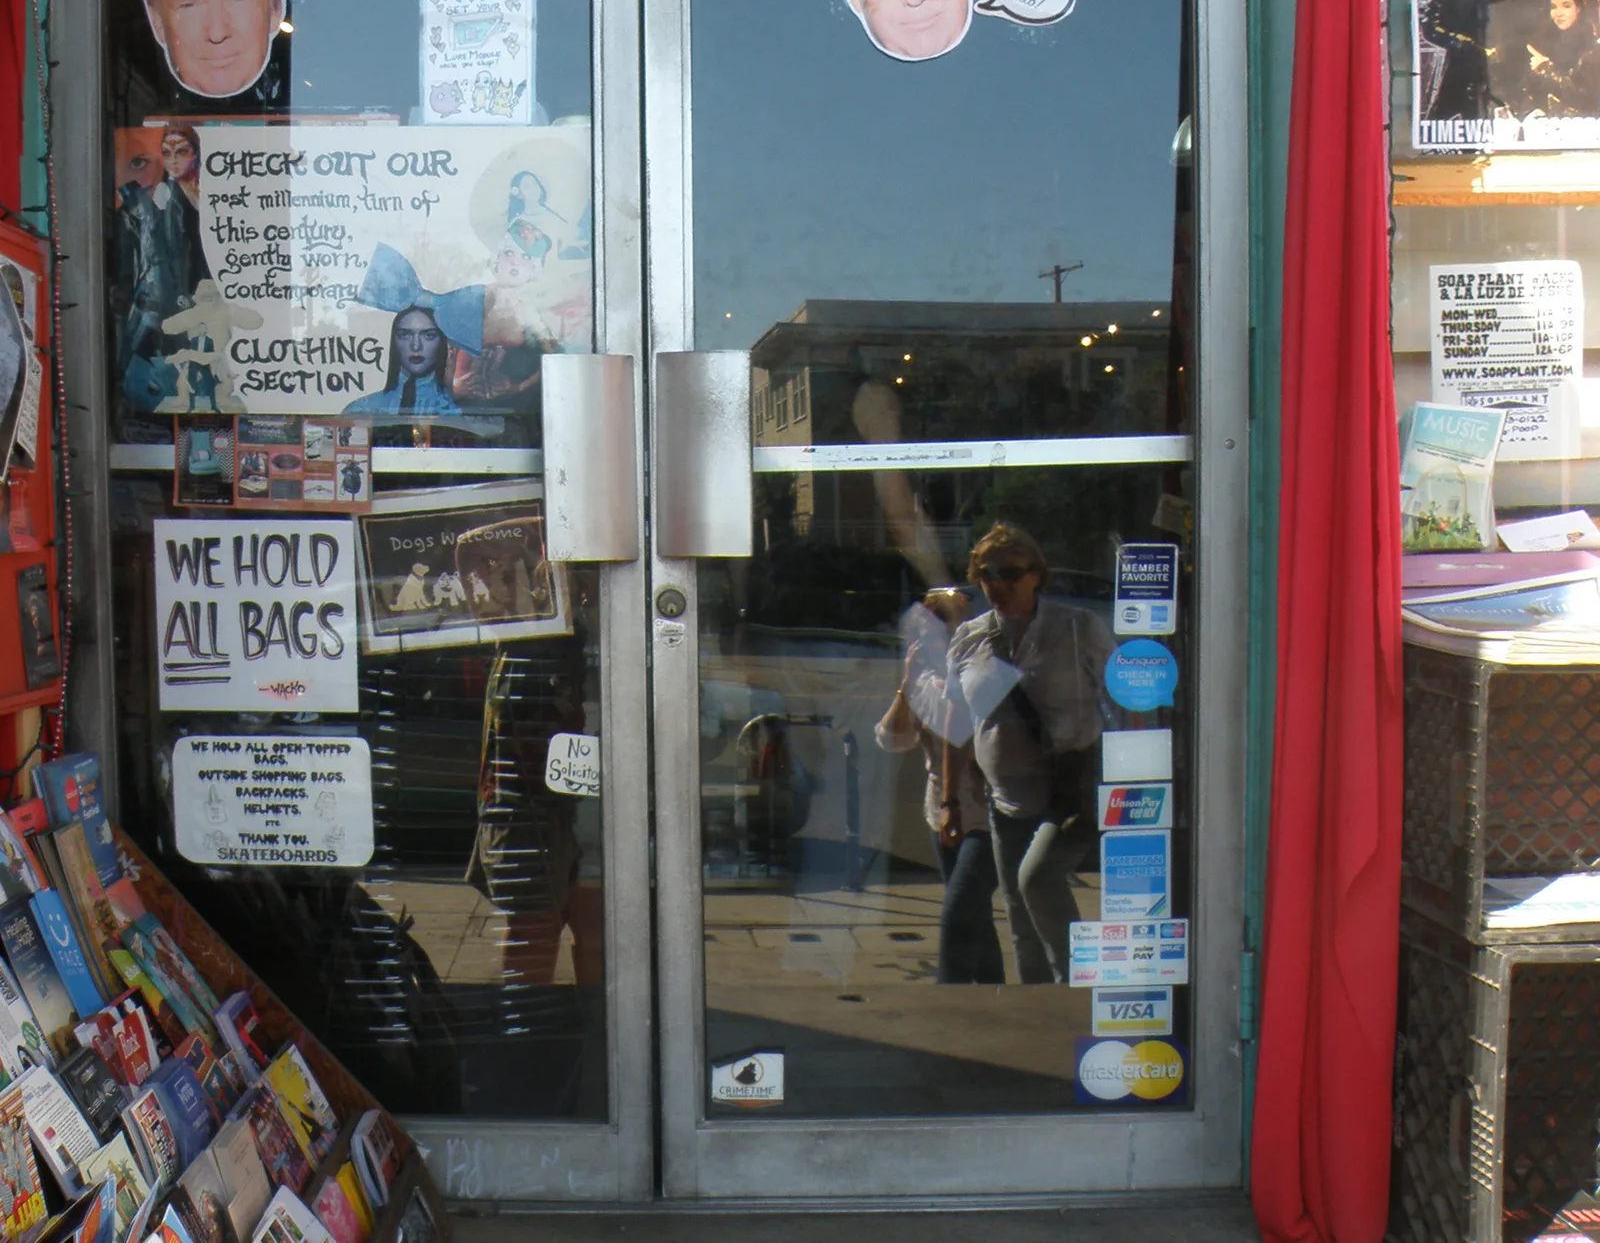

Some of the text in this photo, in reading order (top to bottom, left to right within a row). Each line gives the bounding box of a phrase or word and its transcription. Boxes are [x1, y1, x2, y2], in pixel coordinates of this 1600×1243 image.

[205, 149, 458, 182] CHECK OUT OUR
[208, 185, 440, 217] post millennium, turn of
[210, 215, 354, 250] this century,
[217, 248, 369, 280] gently worn,
[1438, 273, 1475, 288] SOAP
[1478, 273, 1524, 286] PLANT
[1439, 288, 1450, 300] &
[1454, 287, 1474, 300] LA
[1477, 287, 1506, 299] LUZ
[1508, 286, 1525, 298] DE
[230, 335, 385, 371] CLOTHING
[1442, 364, 1574, 380] WWW.SOAPPLANT.COM
[239, 370, 365, 396] SECTION
[1423, 411, 1490, 442] MUSIC
[389, 527, 524, 553] Dogs Welcome
[165, 533, 340, 589] WE HOLD
[1121, 563, 1170, 573] MEMBER
[1121, 572, 1169, 582] FAVORITE
[164, 600, 345, 660] ALL BAGS
[1115, 654, 1168, 667] foursquare
[1117, 670, 1167, 679] CHECK IN
[191, 741, 351, 755] WE HOLD ALL OPEN-TOPPED
[567, 738, 591, 758] No
[198, 770, 248, 782] OUTSIDE
[251, 770, 307, 783] SHOPPING
[549, 758, 600, 781] Solicito
[1111, 795, 1161, 808] UnionPay
[239, 833, 280, 845] THANK
[217, 847, 338, 863] SKATEBOARDS
[1106, 854, 1163, 866] AMERICAN
[1132, 952, 1154, 960] PAY
[1109, 1003, 1155, 1020] VISA
[1081, 1058, 1180, 1081] MasterCard
